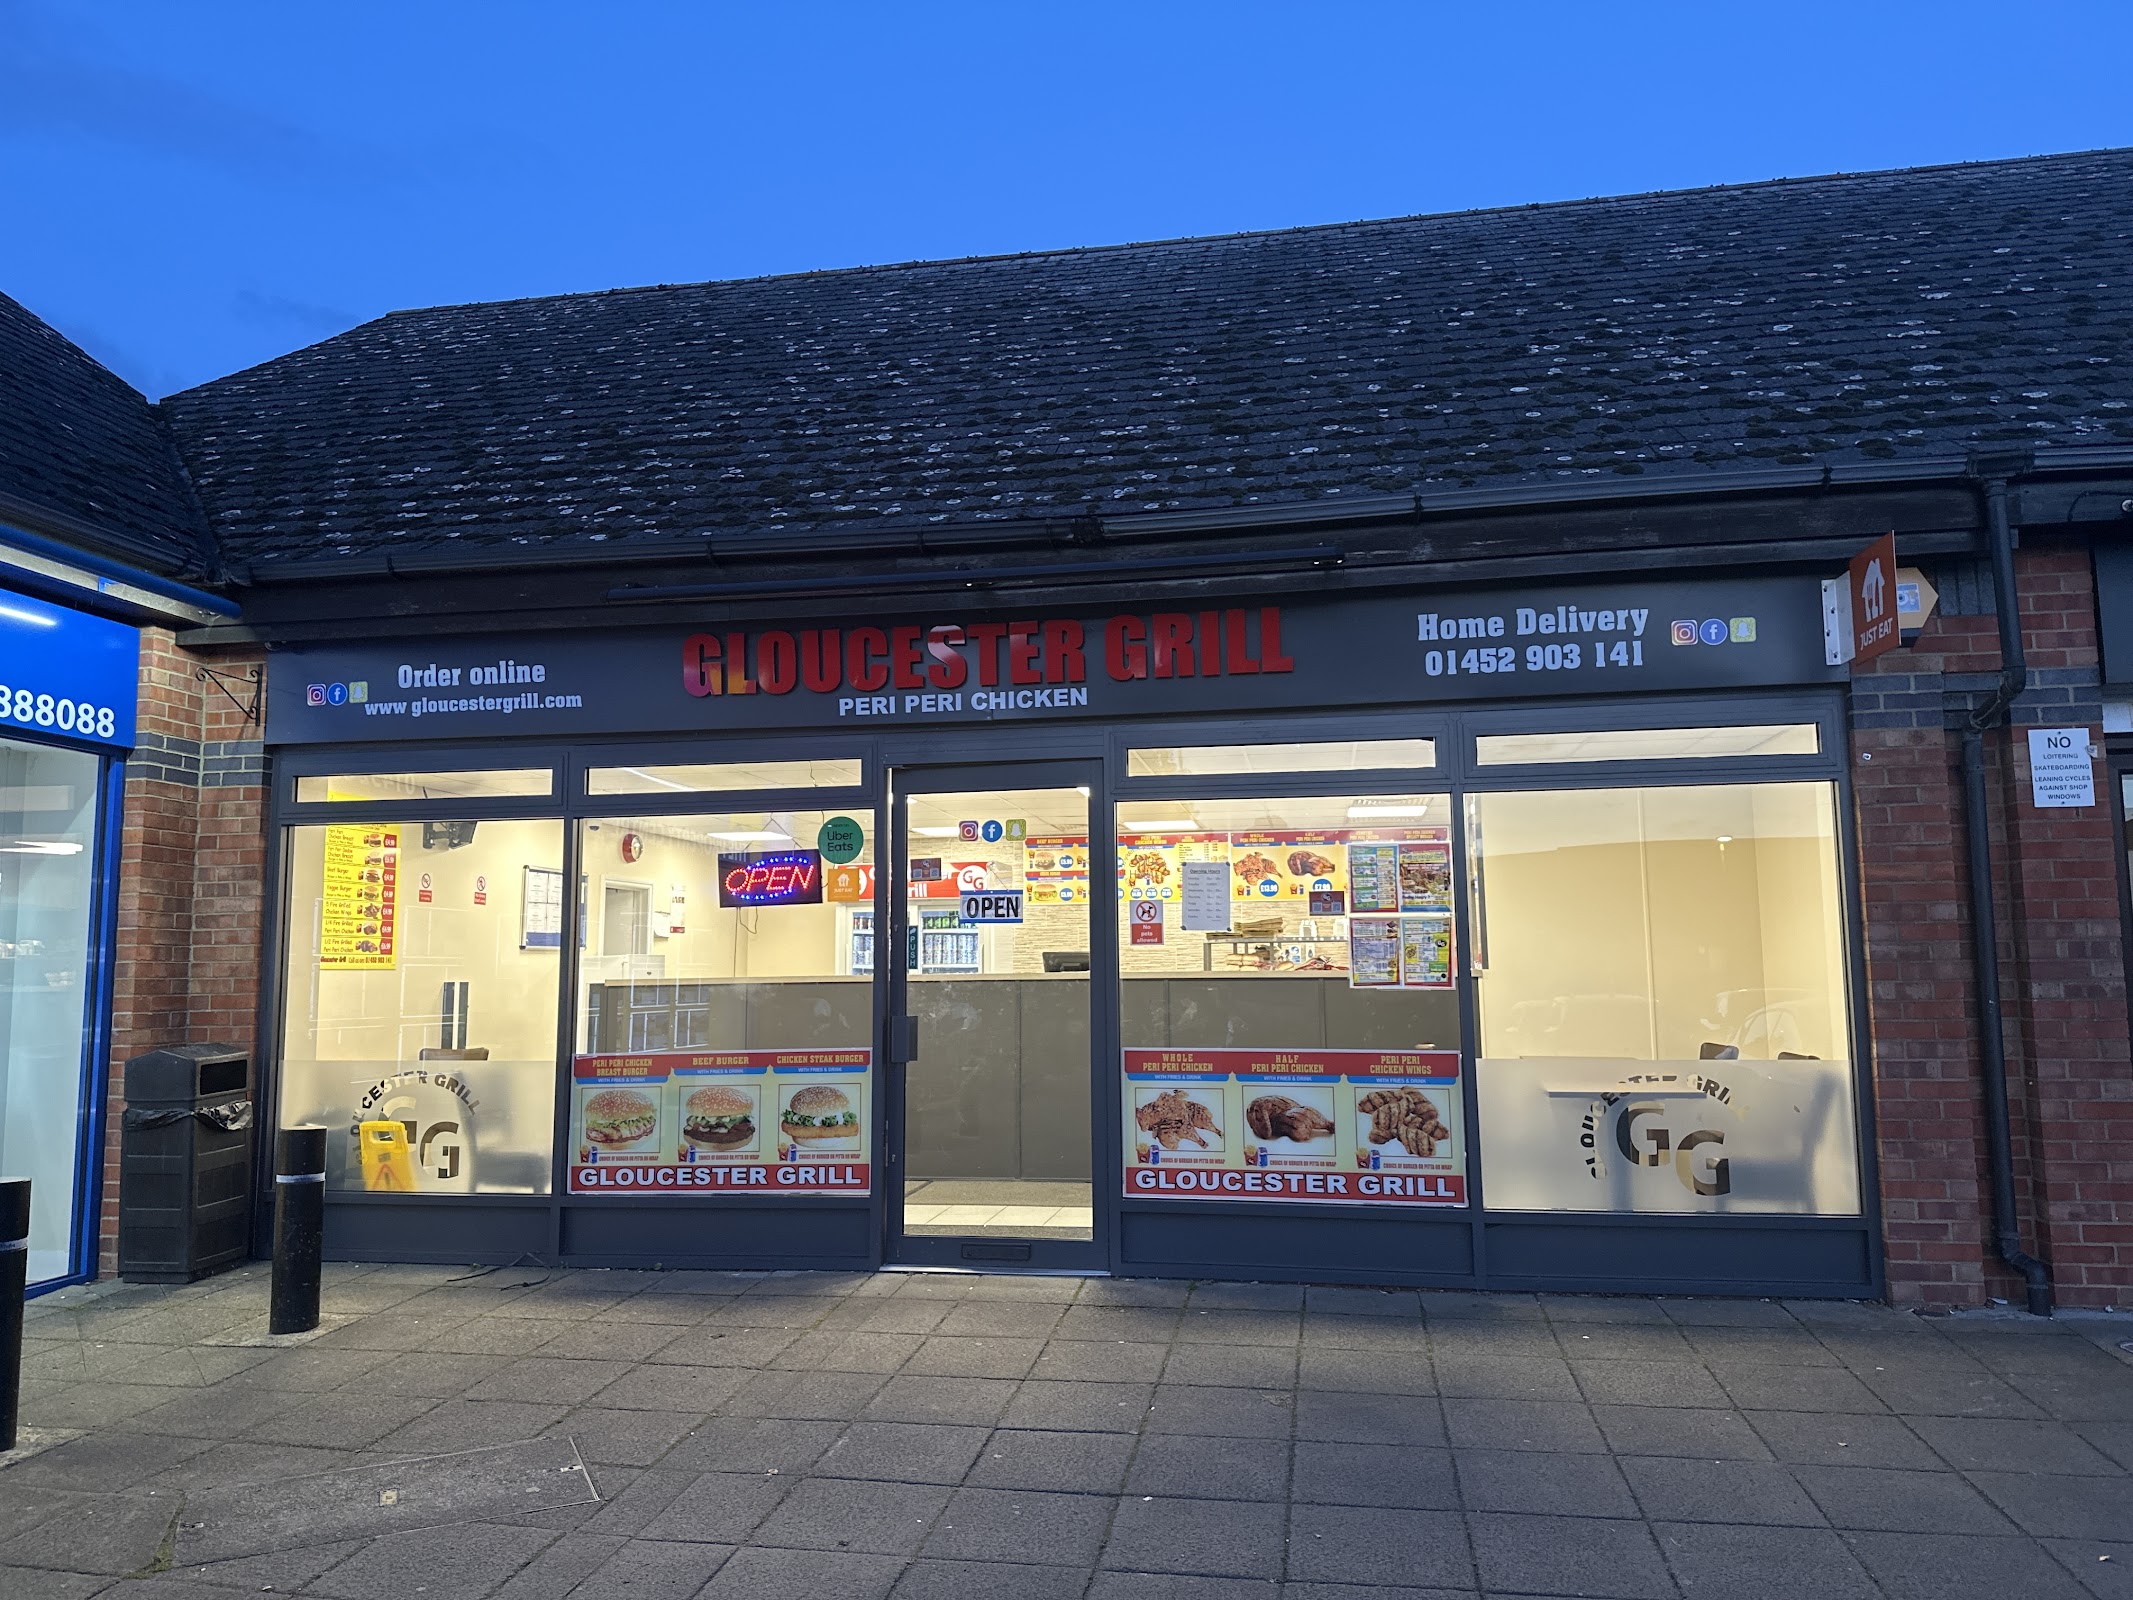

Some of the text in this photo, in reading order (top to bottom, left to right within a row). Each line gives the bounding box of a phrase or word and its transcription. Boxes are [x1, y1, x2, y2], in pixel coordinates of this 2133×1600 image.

[1417, 606, 1649, 641] Home Delivery
[1860, 617, 1893, 651] JUST EAT
[682, 606, 1294, 696] GLOUCESTER GRILL
[1425, 641, 1644, 676] 01452 903 141
[397, 660, 546, 689] Order online
[364, 693, 582, 717] www gloucestergrill.com
[838, 687, 1088, 716] PERI PERI CHICKEN
[2047, 736, 2071, 748] NO
[827, 831, 853, 840] Uber
[827, 842, 854, 852] Eats
[725, 864, 814, 893] OPEN
[966, 896, 1019, 918] OPEN
[608, 1059, 623, 1067] PERI
[625, 1059, 653, 1067] CHICKEN
[692, 1056, 749, 1065] BEEF BURGER
[777, 1055, 864, 1064] CHICKEN STEAK BURGER
[1162, 1053, 1194, 1062] WHOLE
[1275, 1055, 1299, 1063] HALF
[1380, 1055, 1420, 1064] PERI PERI
[596, 1068, 648, 1076] BREAST BURGER
[1142, 1062, 1213, 1071] PERI PERI CHICKEN
[1251, 1064, 1324, 1073] PERI PERI CHICKEN
[1370, 1065, 1432, 1074] CHICKEN WINGS
[578, 1166, 861, 1186] GLOUCESTER GRILL
[1135, 1170, 1456, 1197] GLOUCESTER GRILL
